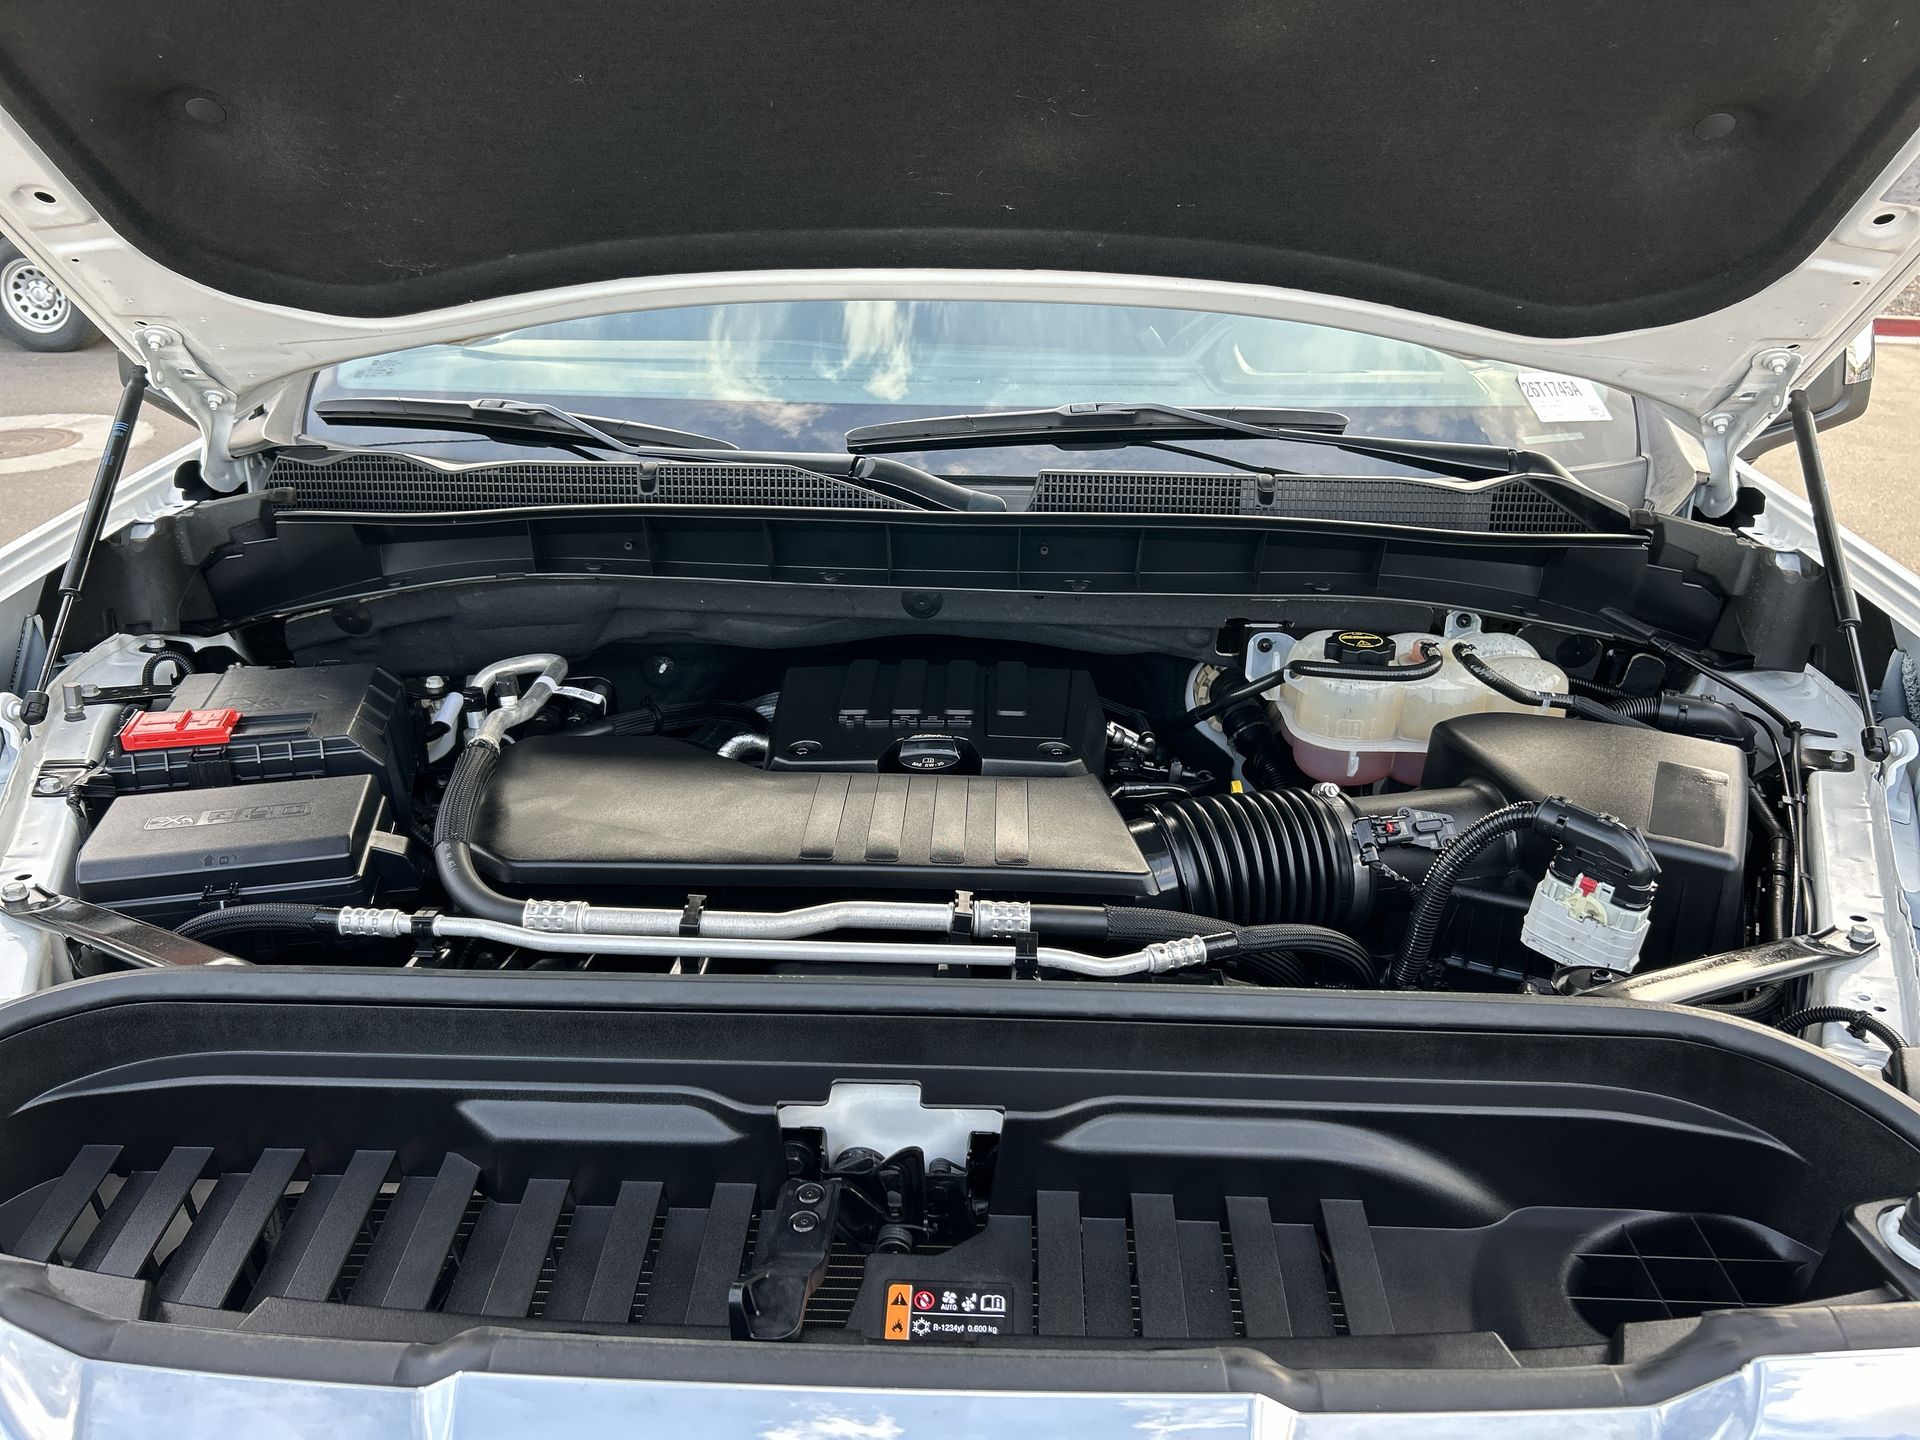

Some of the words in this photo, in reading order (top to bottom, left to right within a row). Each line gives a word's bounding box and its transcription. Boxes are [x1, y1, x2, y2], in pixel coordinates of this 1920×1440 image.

[1521, 380, 1583, 399] 26T1745A
[940, 1303, 958, 1311] AUTO
[932, 1323, 965, 1333] R-1234yf
[967, 1324, 987, 1333] 0.600
[988, 1325, 998, 1335] kg
